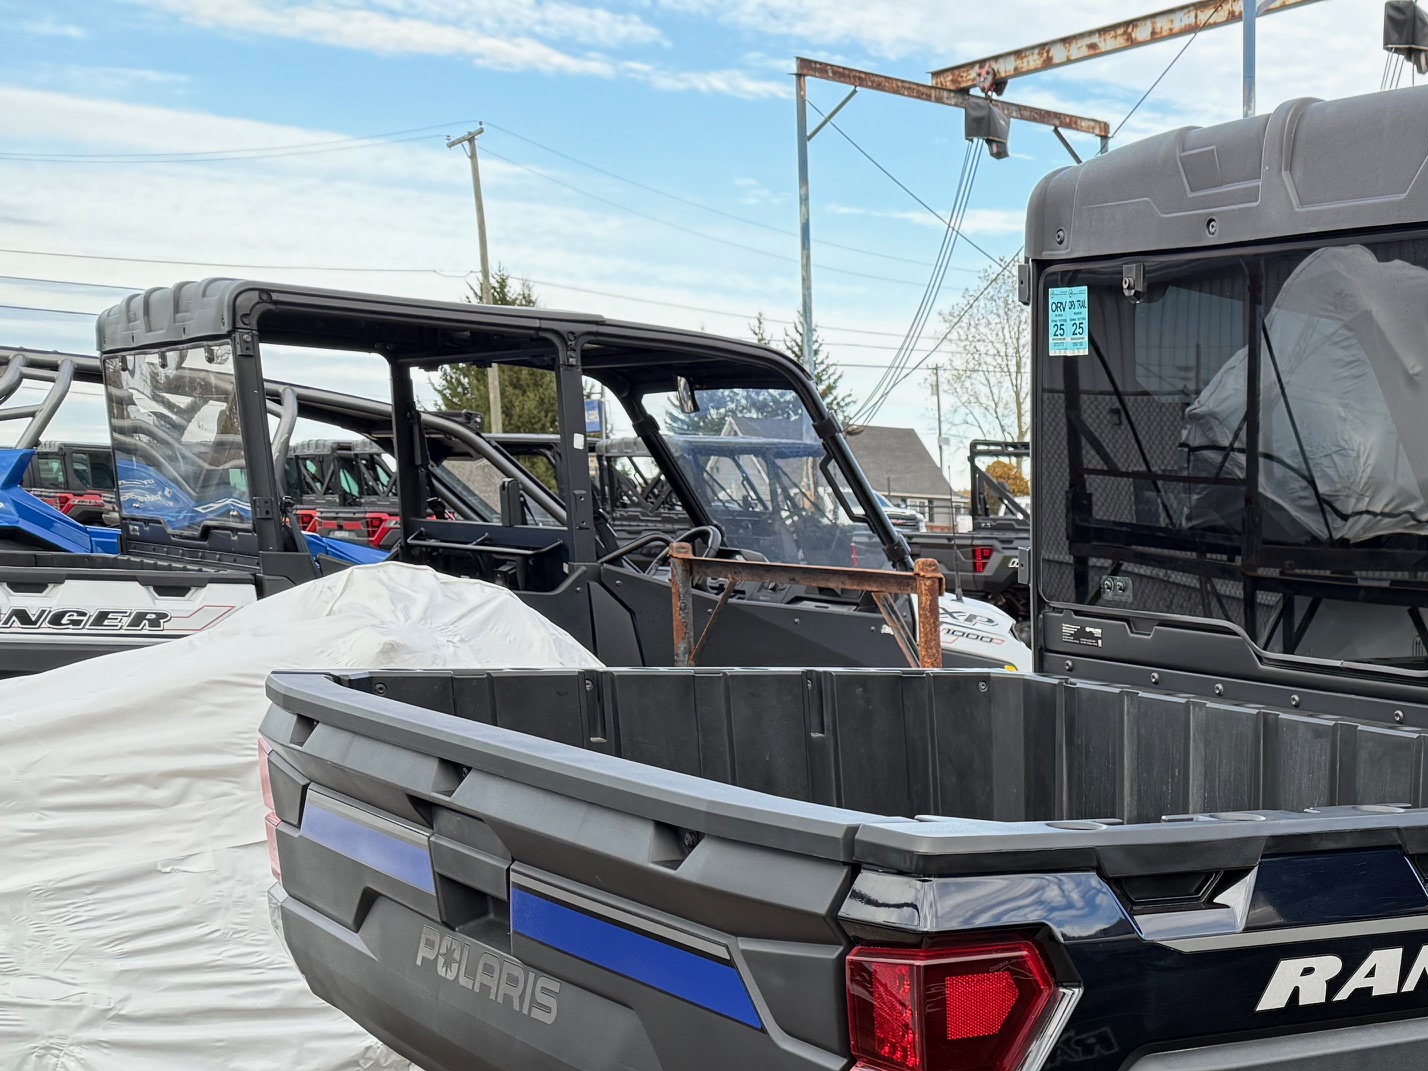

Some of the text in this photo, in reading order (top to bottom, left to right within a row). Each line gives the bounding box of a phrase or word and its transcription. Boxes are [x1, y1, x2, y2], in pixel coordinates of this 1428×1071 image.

[1050, 301, 1067, 313] ORV
[1052, 323, 1065, 337] 25
[1071, 322, 1084, 336] 25
[0, 606, 172, 632] NGER
[944, 628, 993, 644] 1000
[415, 923, 561, 1025] POLARIS
